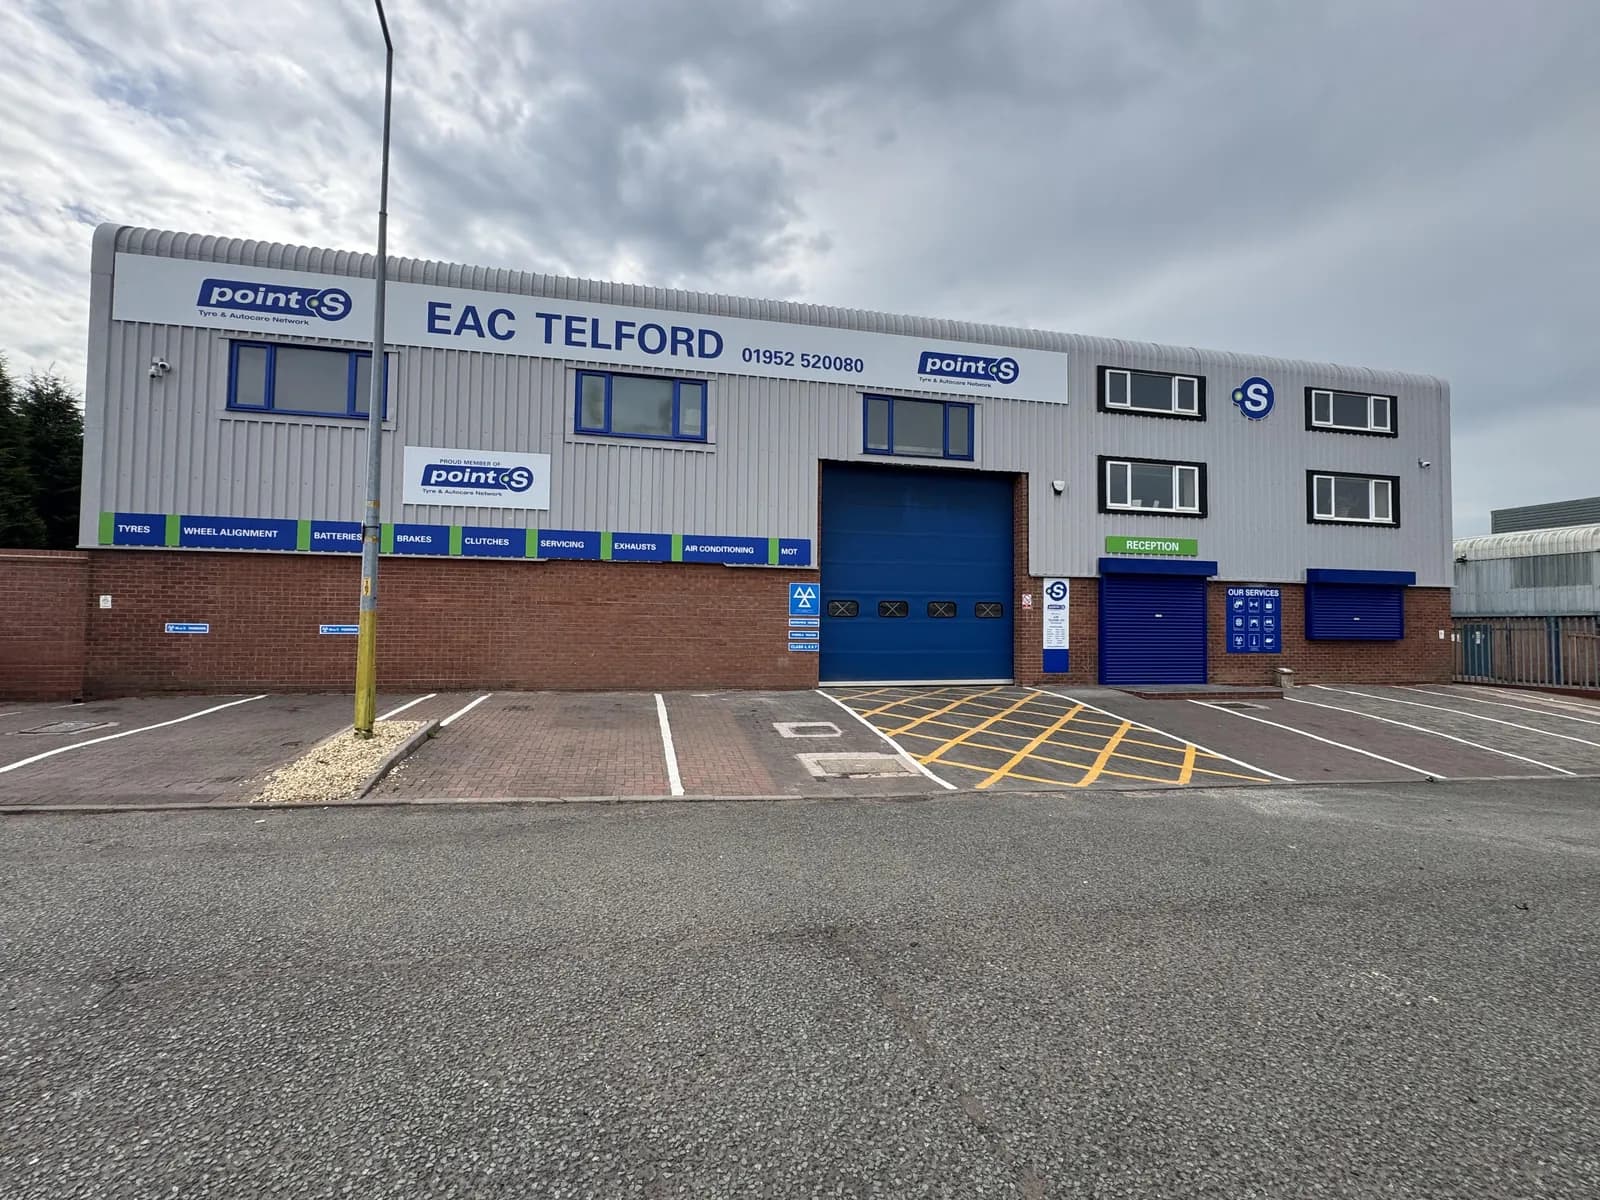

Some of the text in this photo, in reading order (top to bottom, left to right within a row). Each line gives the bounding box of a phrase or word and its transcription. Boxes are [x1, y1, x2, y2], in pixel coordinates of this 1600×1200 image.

[209, 286, 346, 316] point S
[199, 310, 218, 318] Tyre
[230, 312, 270, 322] Autocare
[272, 317, 310, 326] Network
[427, 301, 724, 359] EAC TELFORD
[742, 347, 864, 373] 01952 520080
[926, 357, 1015, 380] point S
[1244, 383, 1269, 412] S
[430, 469, 529, 488] point S
[118, 524, 151, 534] TYRES
[183, 527, 279, 538] WHEEL ALIGNMENT
[313, 531, 363, 541] BATTERIES
[396, 534, 432, 543] BRAKES
[464, 537, 510, 546] CLUTCHES
[540, 539, 585, 549] SERVICING
[614, 542, 657, 551] EXHAUSTS
[699, 545, 754, 554] CONDITIONING
[1126, 540, 1179, 551] RECEPTION
[1228, 588, 1279, 597] OUR SERVICES
